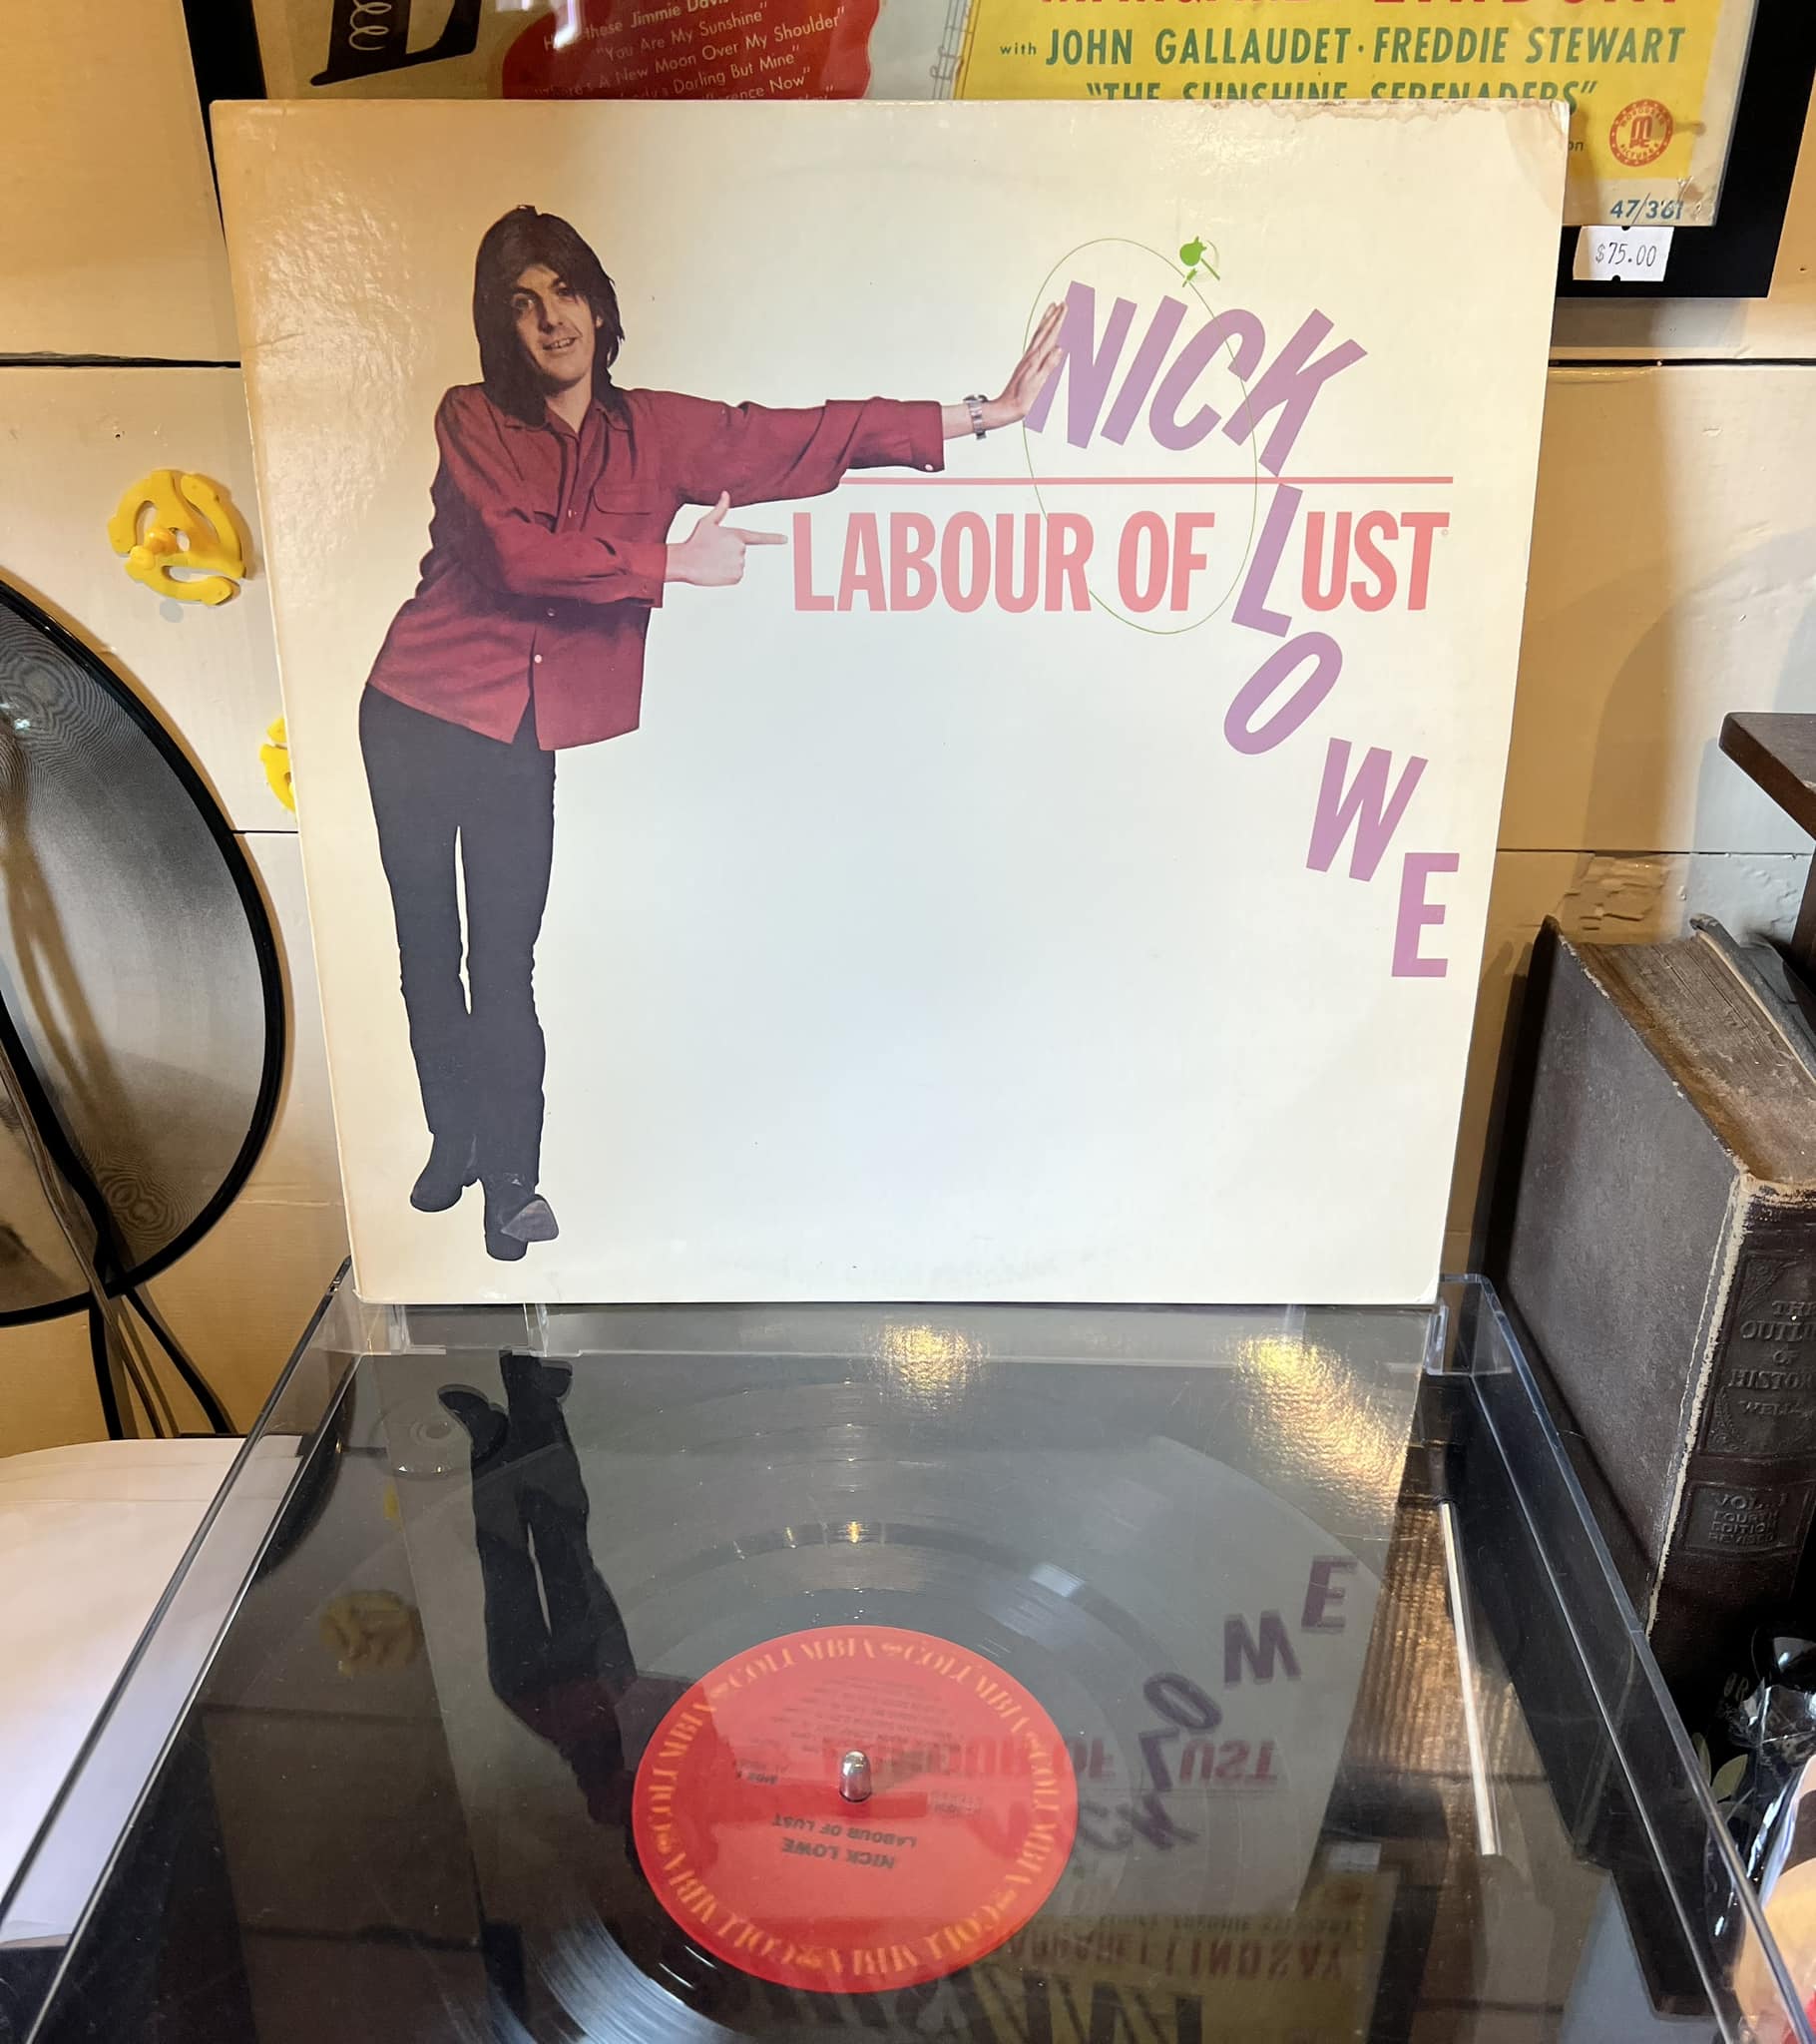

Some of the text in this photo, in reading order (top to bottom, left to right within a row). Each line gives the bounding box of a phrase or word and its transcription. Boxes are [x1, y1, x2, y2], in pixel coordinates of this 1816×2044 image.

[630, 4, 682, 29] Jimmie
[640, 37, 666, 51] Are
[671, 28, 693, 45] My
[698, 1, 767, 38] Sunshine"
[655, 54, 696, 75] Moon
[701, 42, 738, 62] Over
[744, 33, 767, 50] My
[773, 5, 845, 43] Shoulder"
[1000, 26, 1686, 66] with JOHN GALLAUDET FREDDIE STEWART
[673, 71, 726, 95] Darling
[730, 62, 754, 80] But
[759, 44, 800, 72] Mine"
[768, 66, 811, 94] Now"
[1595, 242, 1657, 267] $75.00
[1024, 279, 1368, 477] NICK
[792, 510, 1095, 614] LABOUR
[1117, 510, 1215, 614] OF
[770, 1811, 918, 1848] LABOUR OF LUST
[780, 1837, 896, 1869] NICK LOWE
